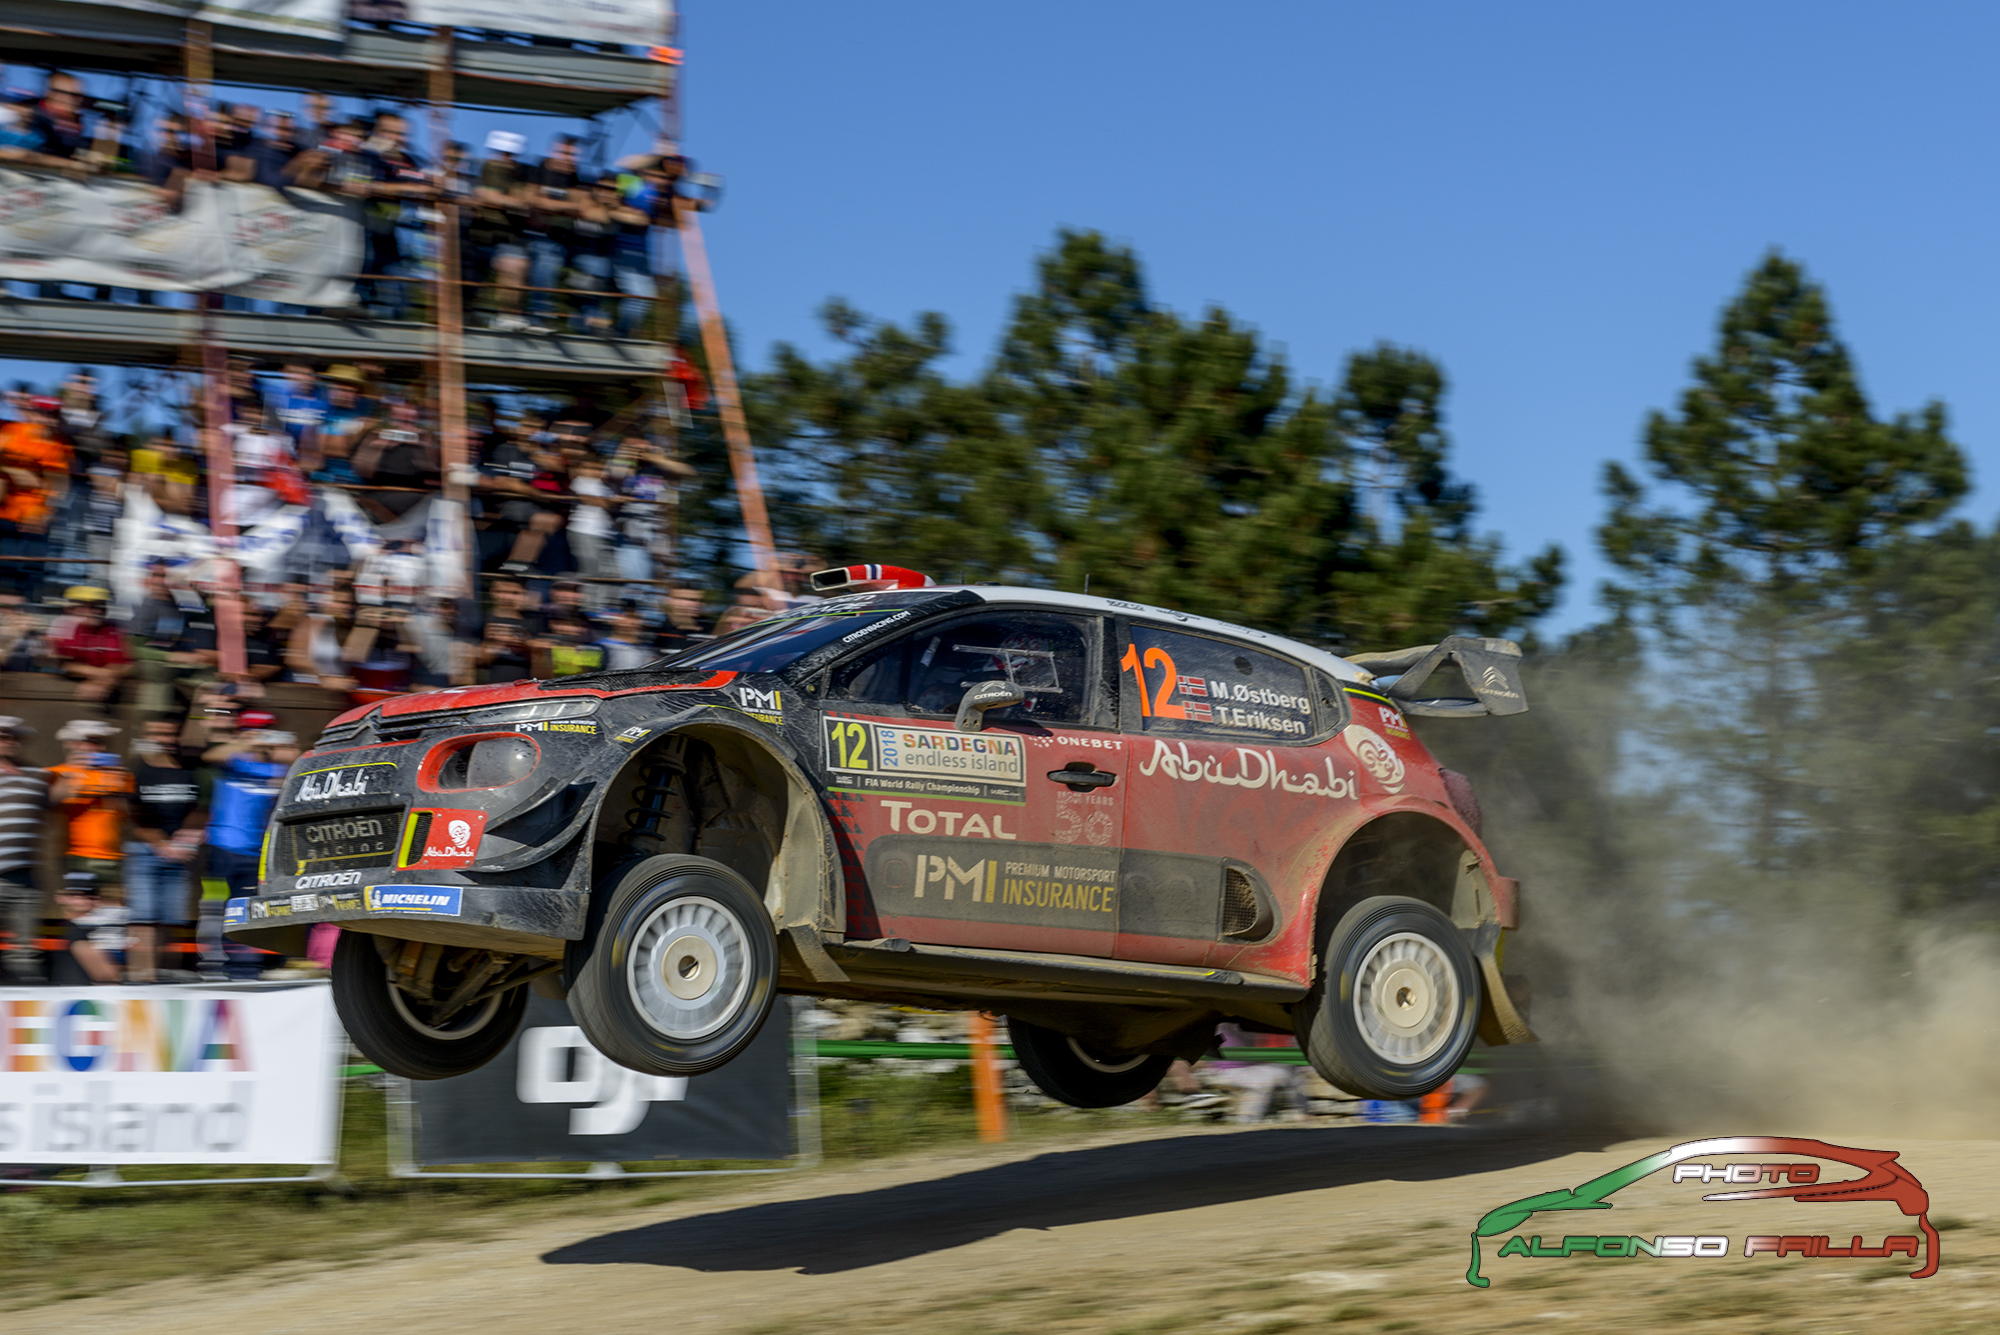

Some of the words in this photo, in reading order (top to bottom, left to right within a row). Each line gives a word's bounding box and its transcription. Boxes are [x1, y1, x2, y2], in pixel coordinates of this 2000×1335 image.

[1120, 643, 1187, 720] 12
[515, 721, 548, 733] PMI
[549, 723, 597, 735] INSURANCE
[1215, 706, 1306, 735] T.Eriksen
[831, 721, 869, 769] 12
[880, 729, 899, 767] 2018
[902, 733, 1017, 757] SARDEGNA
[1056, 736, 1123, 751] ONEBET
[905, 750, 967, 769] endless
[971, 754, 1018, 774] island
[864, 777, 879, 788] FIA
[880, 778, 904, 790] World
[905, 780, 925, 792] Rally
[926, 782, 980, 796] Championship
[880, 799, 1017, 840] TOTAL
[914, 854, 998, 904] PMI
[1005, 861, 1050, 879] PREMIUM
[1053, 865, 1117, 884] MOTORSPORT
[381, 893, 451, 907] MICHELIN
[1002, 878, 1115, 913] INSURANCE
